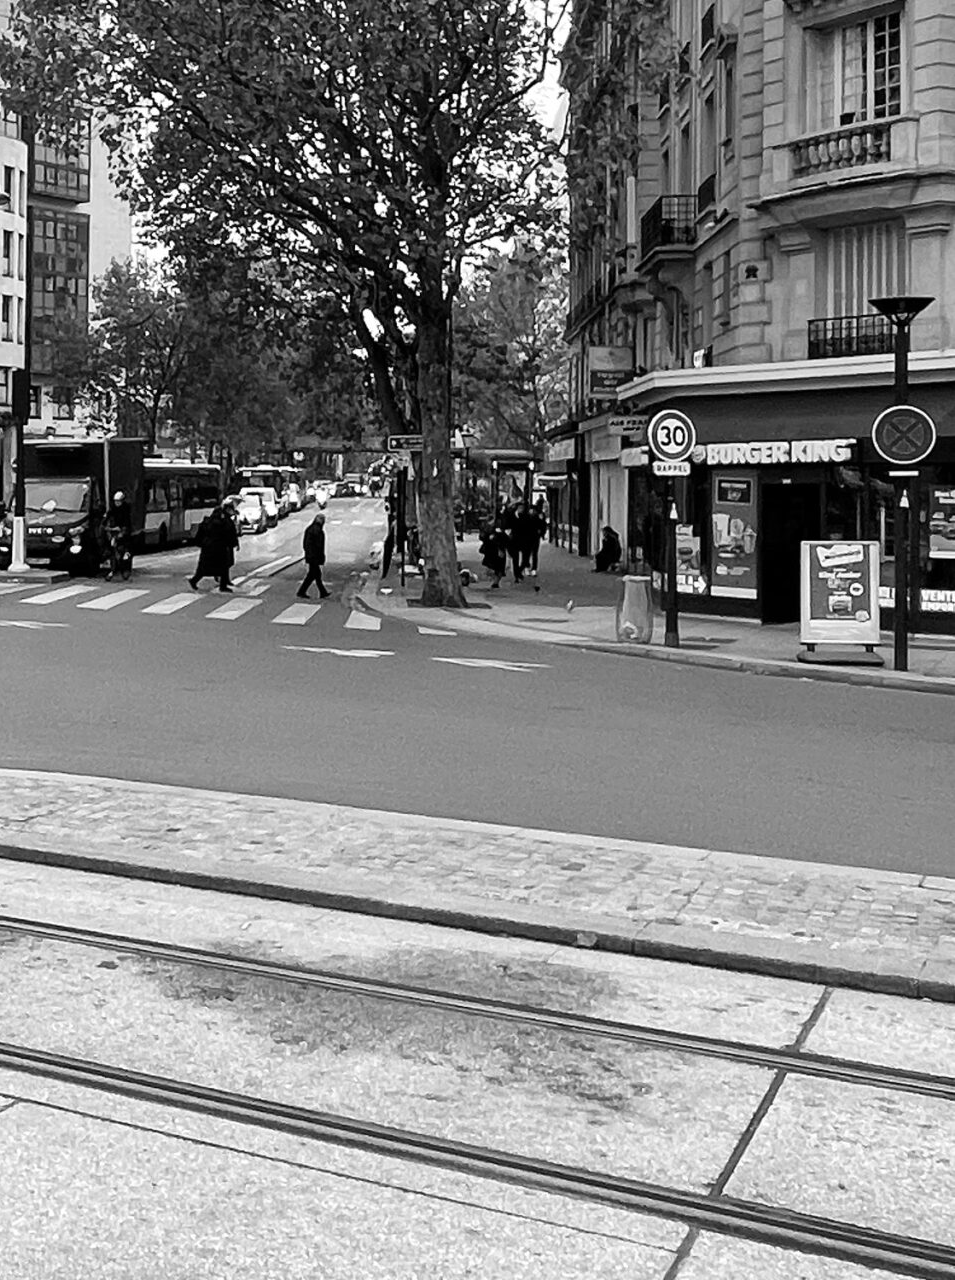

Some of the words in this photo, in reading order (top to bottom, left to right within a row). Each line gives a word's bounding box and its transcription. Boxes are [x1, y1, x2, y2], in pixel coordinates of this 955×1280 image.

[660, 426, 685, 446] 30
[707, 441, 790, 465] BURGER
[791, 438, 853, 463] KING
[656, 464, 688, 473] RAPPEL
